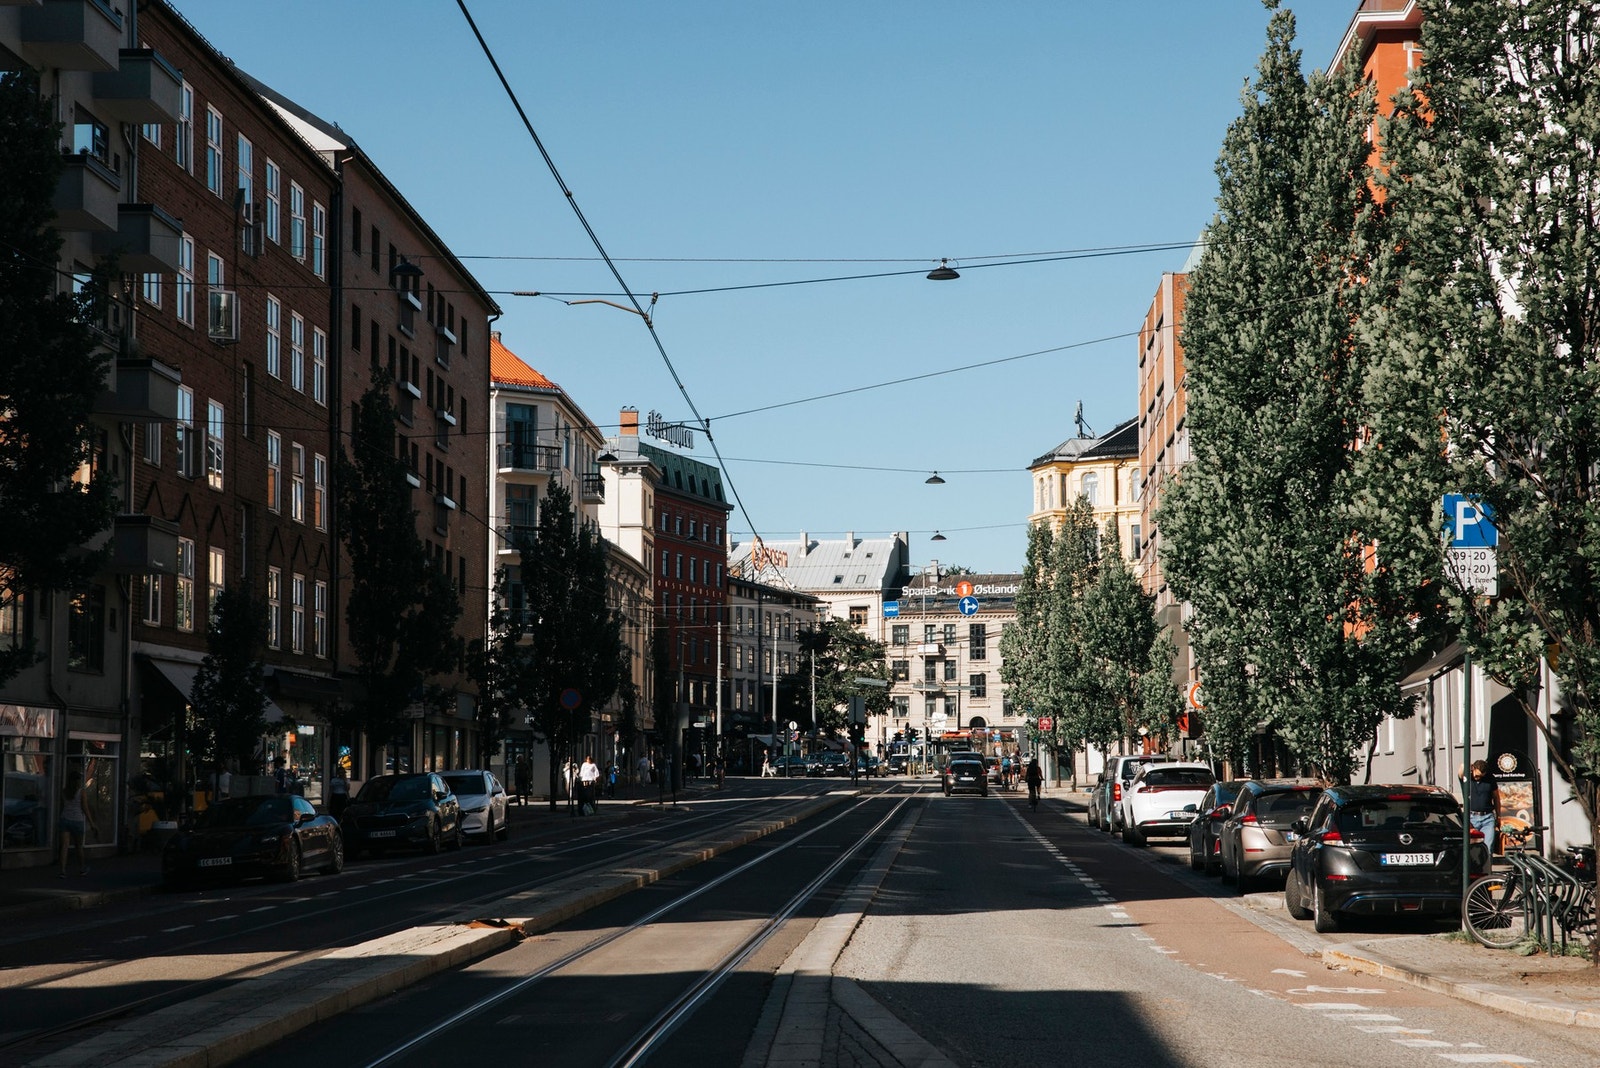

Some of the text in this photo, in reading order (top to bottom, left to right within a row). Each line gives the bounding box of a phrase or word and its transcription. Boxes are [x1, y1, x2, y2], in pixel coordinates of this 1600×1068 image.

[1456, 501, 1484, 540] P
[901, 585, 956, 597] SpareBank
[1390, 855, 1430, 863] EV 21135
